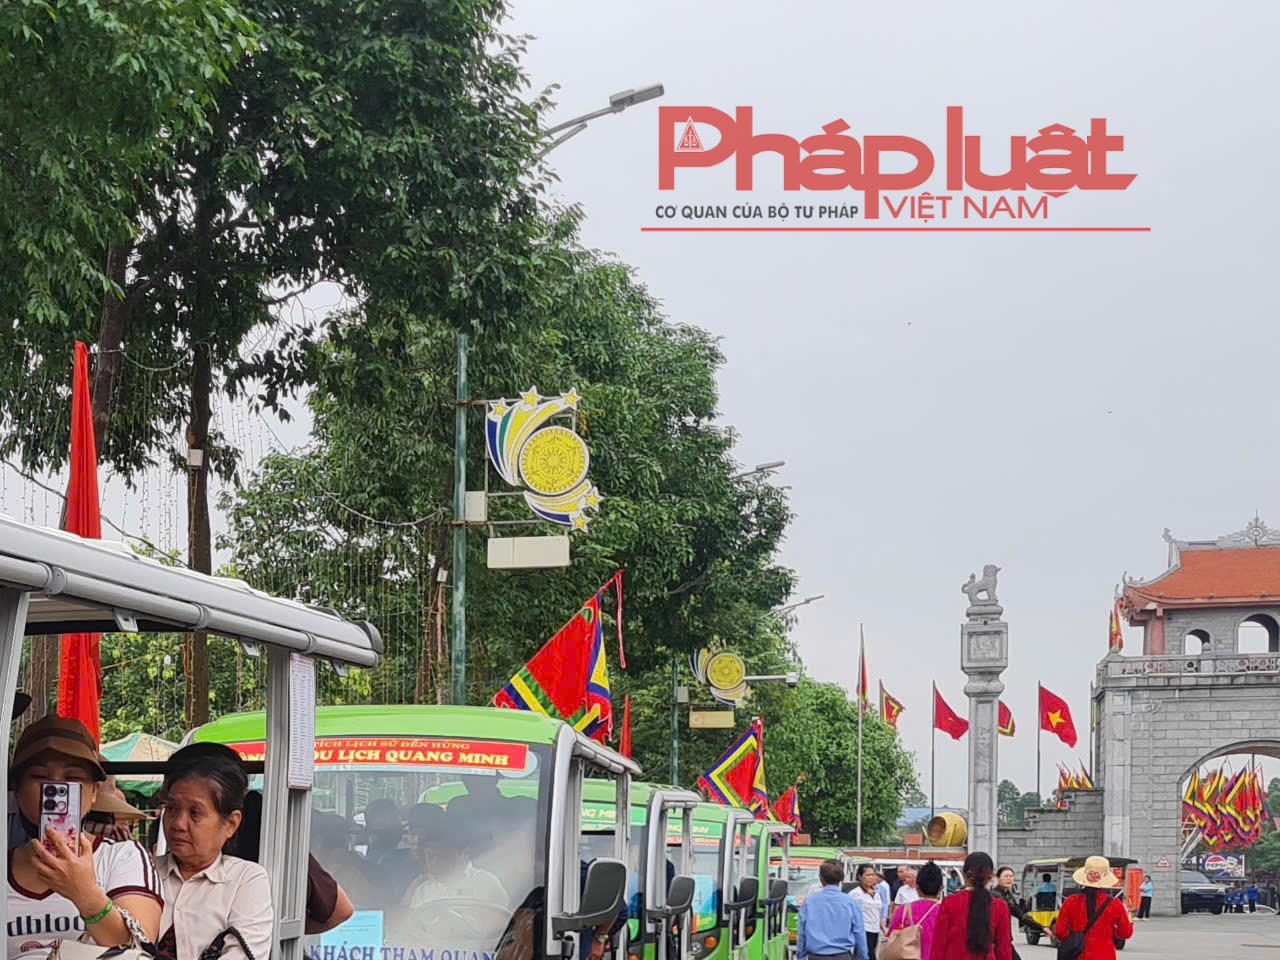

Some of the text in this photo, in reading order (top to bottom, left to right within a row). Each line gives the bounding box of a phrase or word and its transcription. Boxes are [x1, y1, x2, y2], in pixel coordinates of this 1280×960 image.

[338, 749, 381, 763] LỊCH
[385, 750, 453, 763] QUANG
[458, 752, 510, 766] MINH
